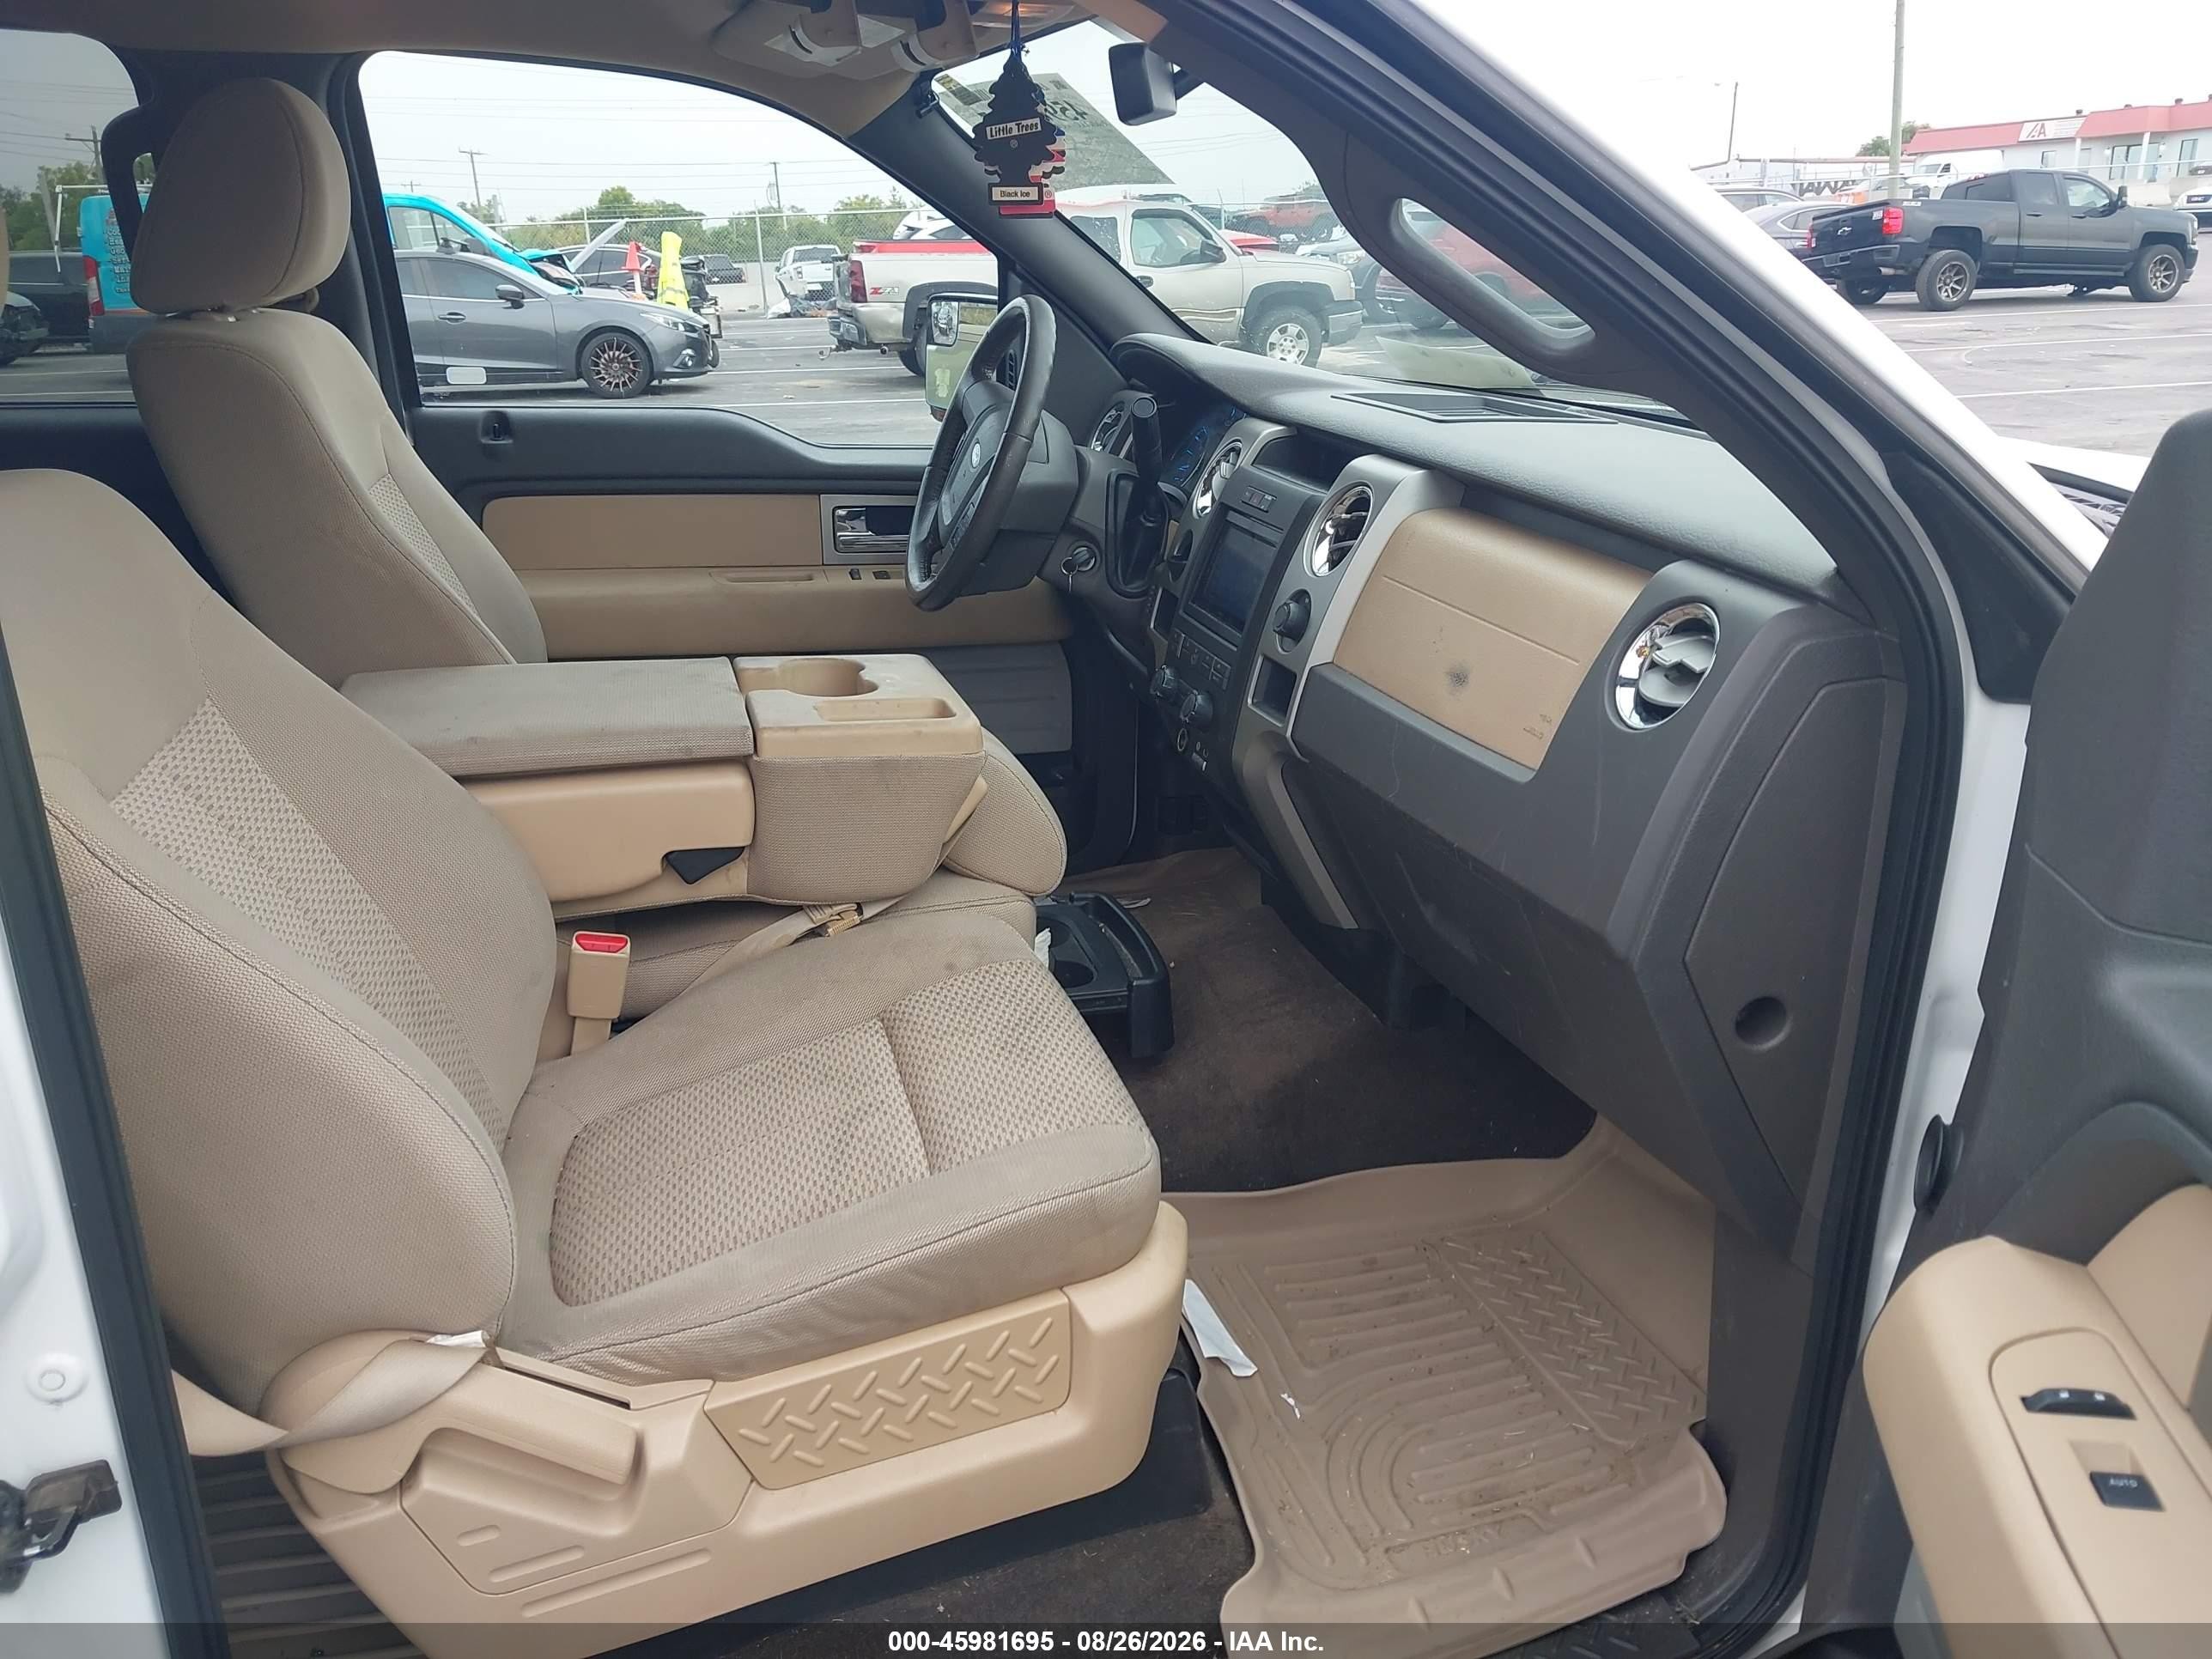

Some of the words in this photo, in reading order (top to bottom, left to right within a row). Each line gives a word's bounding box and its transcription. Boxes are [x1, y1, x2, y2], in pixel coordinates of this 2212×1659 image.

[989, 125, 1013, 138] Little
[1014, 121, 1039, 133] Trees
[2110, 1478, 2138, 1488] AUTO
